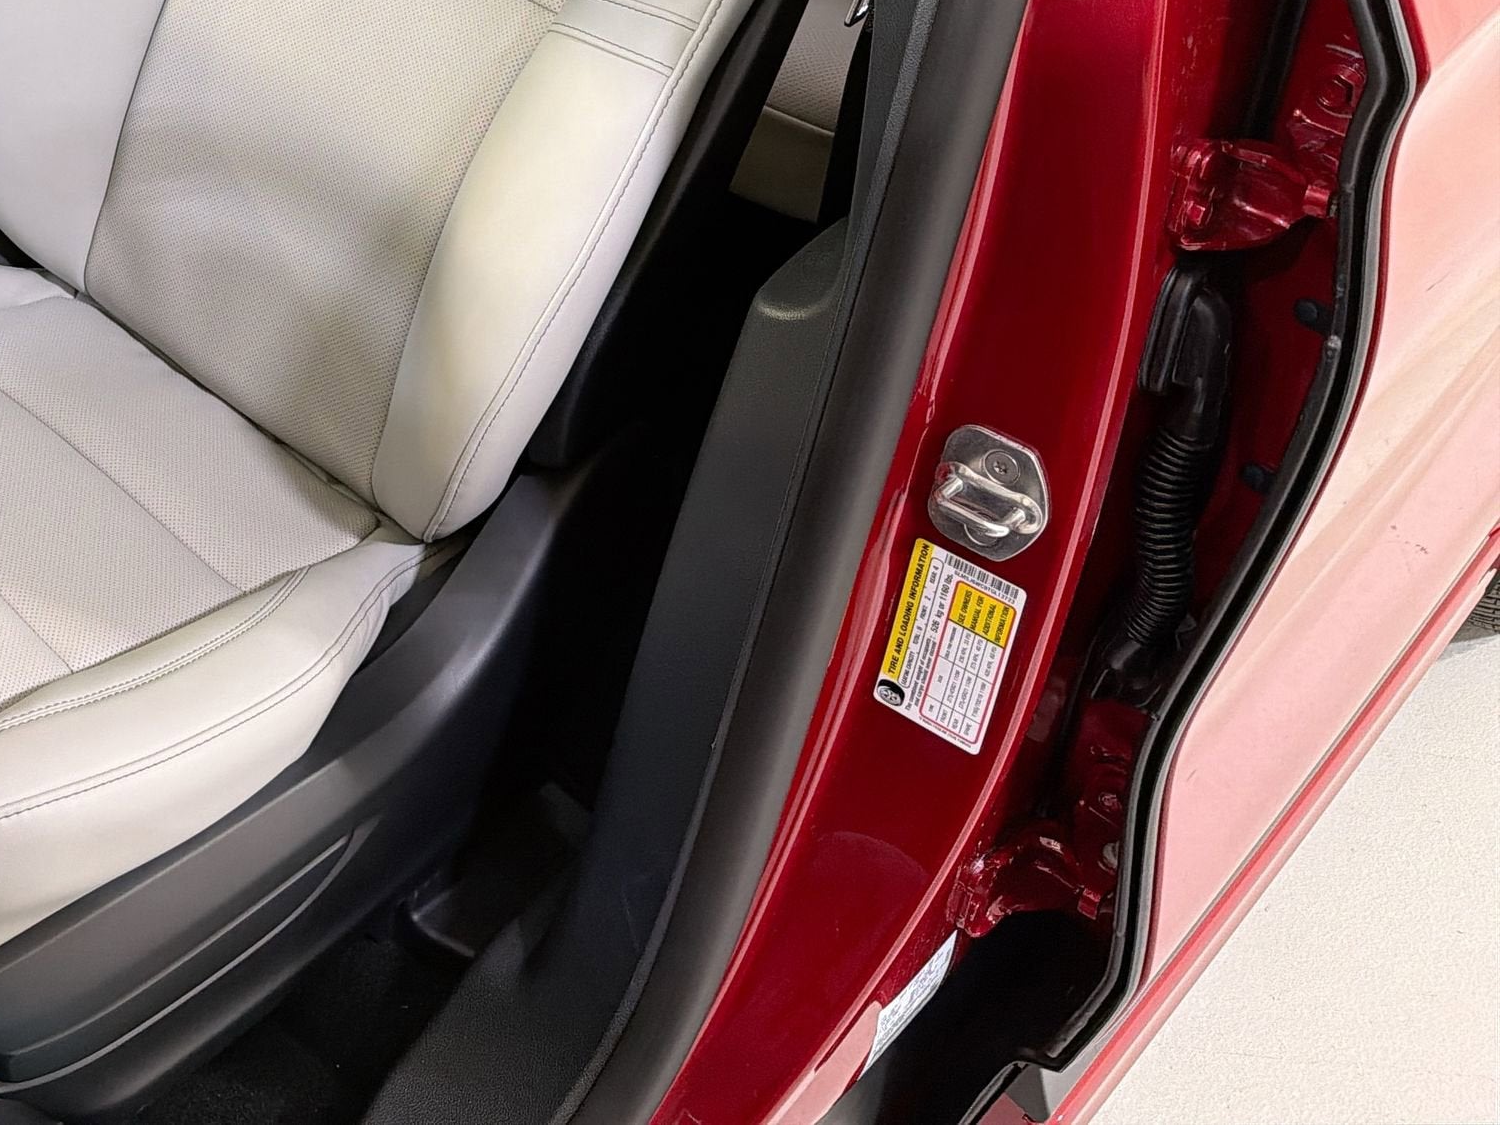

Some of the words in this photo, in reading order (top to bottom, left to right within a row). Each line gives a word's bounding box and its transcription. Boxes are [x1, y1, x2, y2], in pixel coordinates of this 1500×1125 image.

[908, 542, 930, 600] INFORMATION
[938, 583, 950, 601] 1160
[959, 588, 972, 613] OWNERS
[934, 608, 944, 619] kg
[938, 600, 945, 610] or
[969, 607, 981, 630] MANUAL
[975, 594, 984, 607] FOR
[898, 600, 914, 636] LOADING
[929, 618, 940, 633] 526
[957, 612, 965, 624] SEE
[981, 602, 996, 635] ADDITIONAL
[993, 604, 1010, 643] INFORMATION
[893, 636, 904, 654] AND
[887, 654, 899, 675] TIRE
